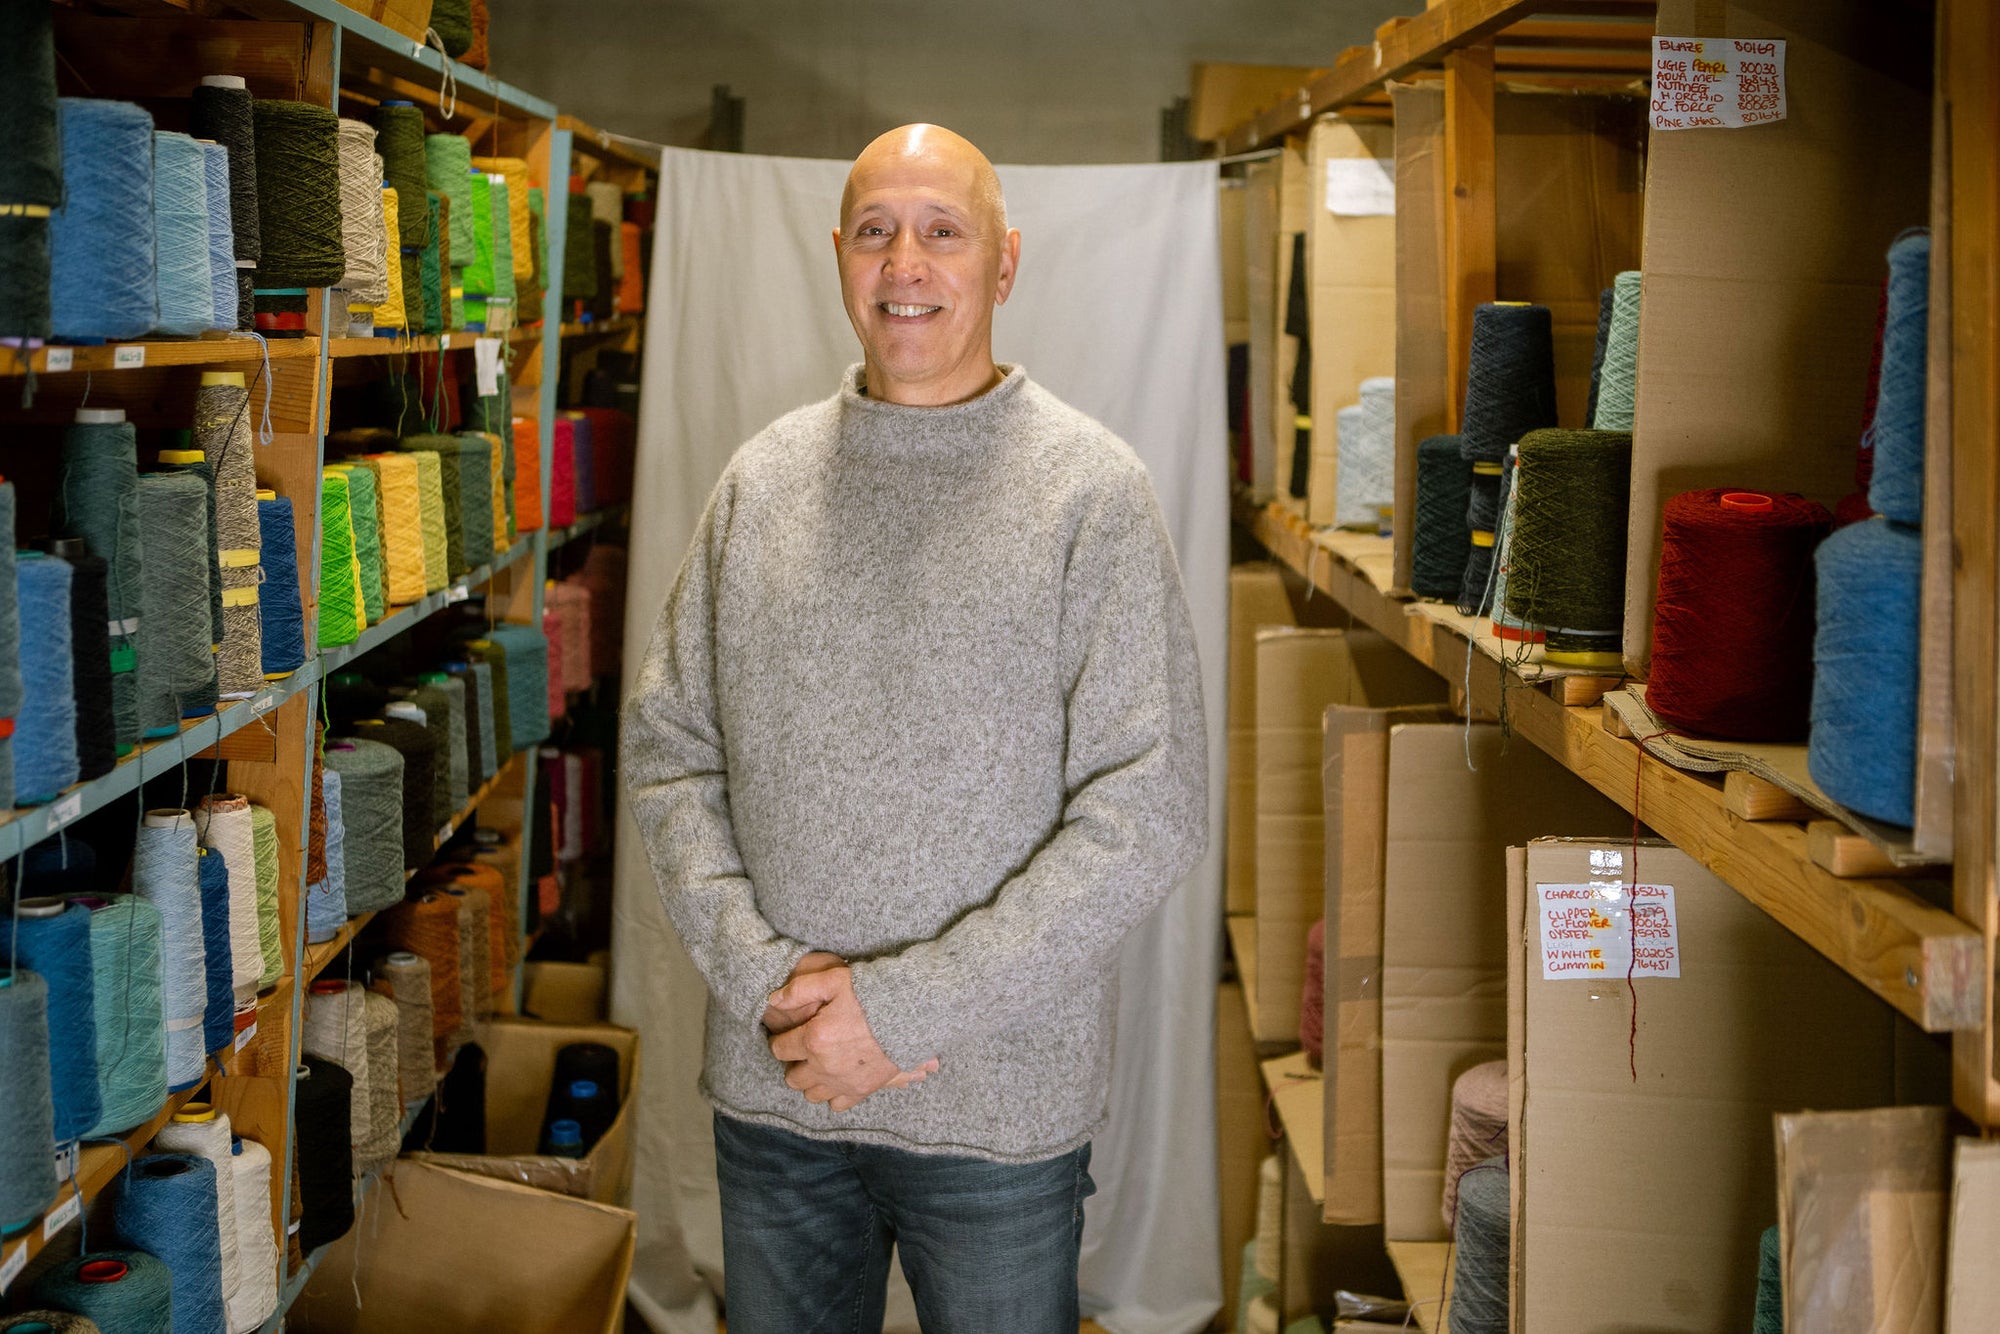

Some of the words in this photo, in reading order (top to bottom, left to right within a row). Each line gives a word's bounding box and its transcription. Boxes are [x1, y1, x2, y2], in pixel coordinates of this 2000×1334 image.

[1659, 40, 1704, 53] BLAZE
[1734, 41, 1775, 57] 80169
[1692, 59, 1729, 73] PEARL
[1741, 61, 1776, 75] 80030
[1693, 74, 1722, 83] MEL
[1657, 81, 1710, 94] NUTMEG
[1656, 115, 1684, 128] PINE
[1741, 111, 1781, 122] 80164
[1545, 888, 1606, 900] CHARCO
[1548, 908, 1599, 920] CLIPPER
[1549, 929, 1593, 939] OYSTER
[1634, 947, 1675, 958] 80205
